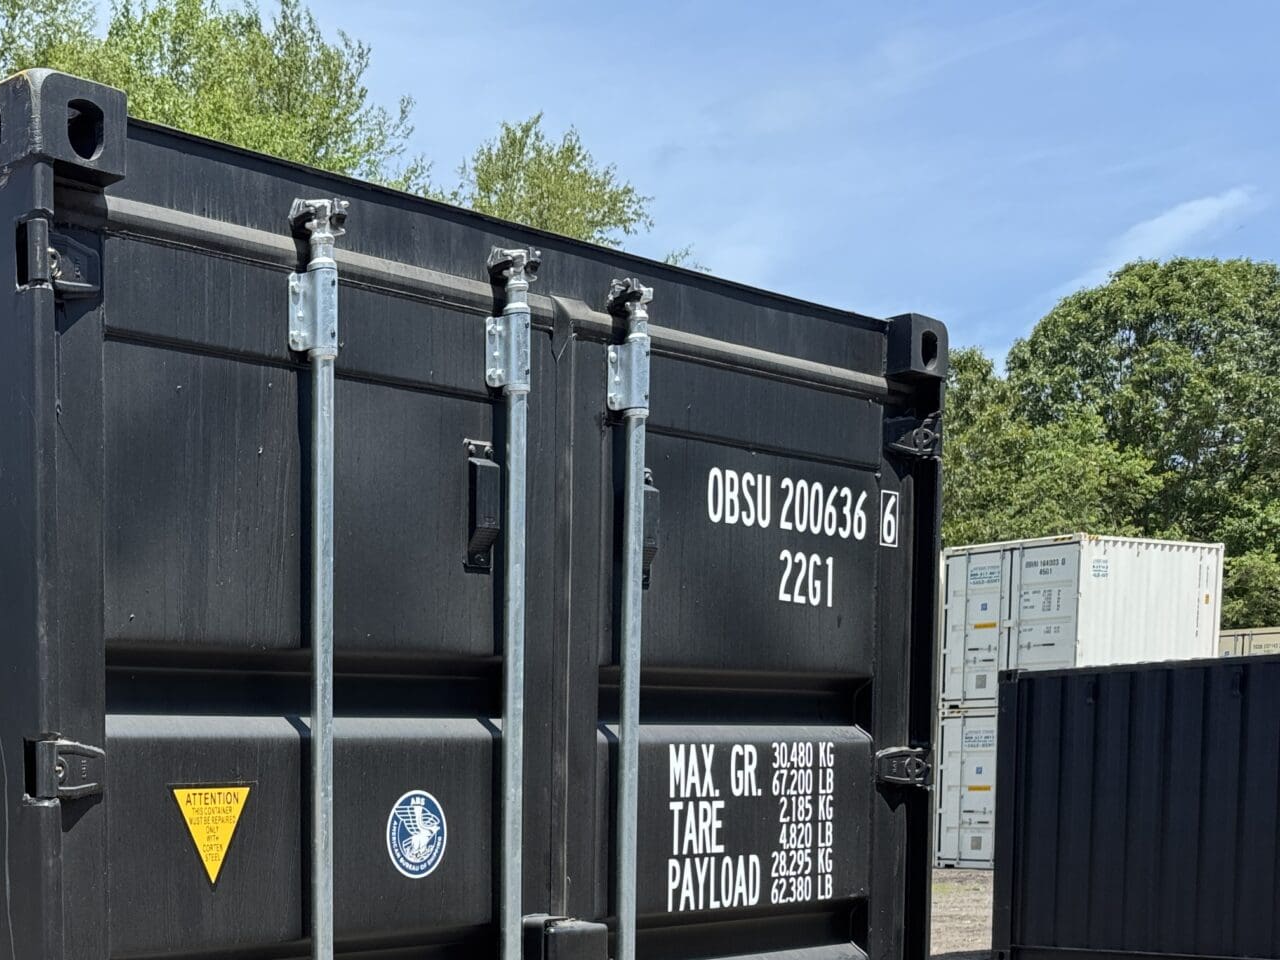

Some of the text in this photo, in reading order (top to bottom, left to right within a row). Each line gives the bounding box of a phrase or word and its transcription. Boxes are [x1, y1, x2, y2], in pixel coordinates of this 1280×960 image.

[707, 466, 897, 544] OBSU 200636 6
[778, 549, 834, 608] 22G1
[669, 741, 835, 798] MAX. GR. 30,480 KG
[771, 768, 834, 796] 67,200 LB
[185, 791, 240, 806] ATTENTION
[192, 806, 233, 816] THIS CONTAINER
[189, 815, 237, 826] MUST BE REPAIRED
[205, 825, 219, 835] ONLY
[669, 800, 725, 856] TARE
[818, 795, 834, 821] KG
[817, 821, 834, 848] LB
[205, 852, 221, 863] STEEL
[667, 854, 761, 913] PAYLOAD
[817, 848, 833, 874] KG
[817, 874, 833, 900] LB
